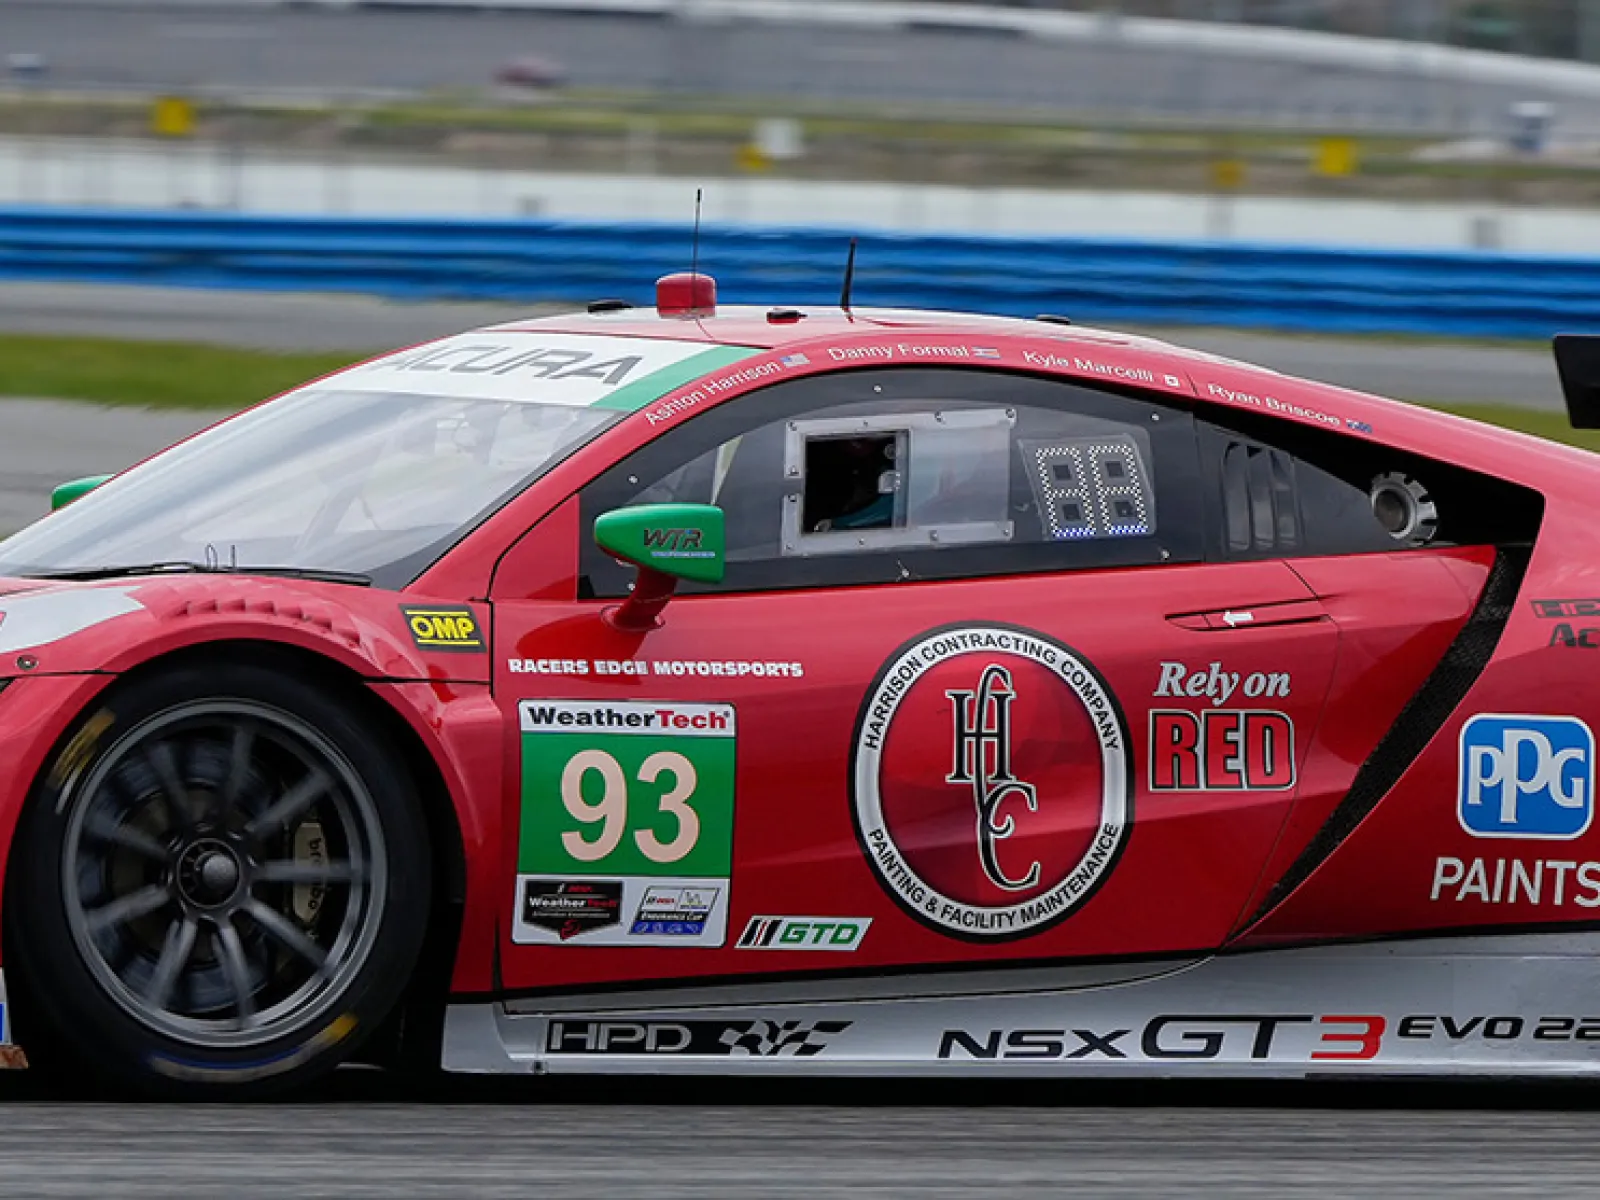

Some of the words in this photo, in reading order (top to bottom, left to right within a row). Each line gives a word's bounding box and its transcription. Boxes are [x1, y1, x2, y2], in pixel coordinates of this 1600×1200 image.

[372, 345, 643, 385] ACURA
[827, 345, 893, 361] Danny
[897, 343, 970, 359] Formal
[1022, 350, 1069, 369] Kyle
[1074, 357, 1154, 383] Marcelli
[645, 389, 707, 426] Ashton
[702, 361, 781, 395] Harrison
[1207, 383, 1261, 406] Ryan
[1265, 397, 1341, 426] Briscoe
[643, 528, 704, 552] WTR
[410, 615, 475, 640] OMP
[508, 658, 590, 675] RACERS
[594, 659, 649, 676] EDGE
[653, 660, 804, 678] MOTORSPORTS
[1153, 661, 1240, 706] Rely
[1243, 669, 1291, 698] on
[864, 656, 923, 750] HARRISON
[921, 632, 1057, 664] CONTRACTING
[1060, 659, 1120, 751] COMPANY
[1148, 708, 1297, 792] RED
[1467, 728, 1587, 825] PPG
[560, 748, 702, 863] 93
[867, 828, 925, 903] PAINTING
[925, 897, 938, 912] &
[940, 904, 1018, 930] FACILITY
[1020, 823, 1120, 923] MAINTENANCE
[1430, 856, 1600, 908] PAINTS
[778, 922, 860, 945] GTD
[549, 1022, 692, 1052] HPD
[1396, 1016, 1525, 1039] EVO
[1532, 1016, 1600, 1039] 22
